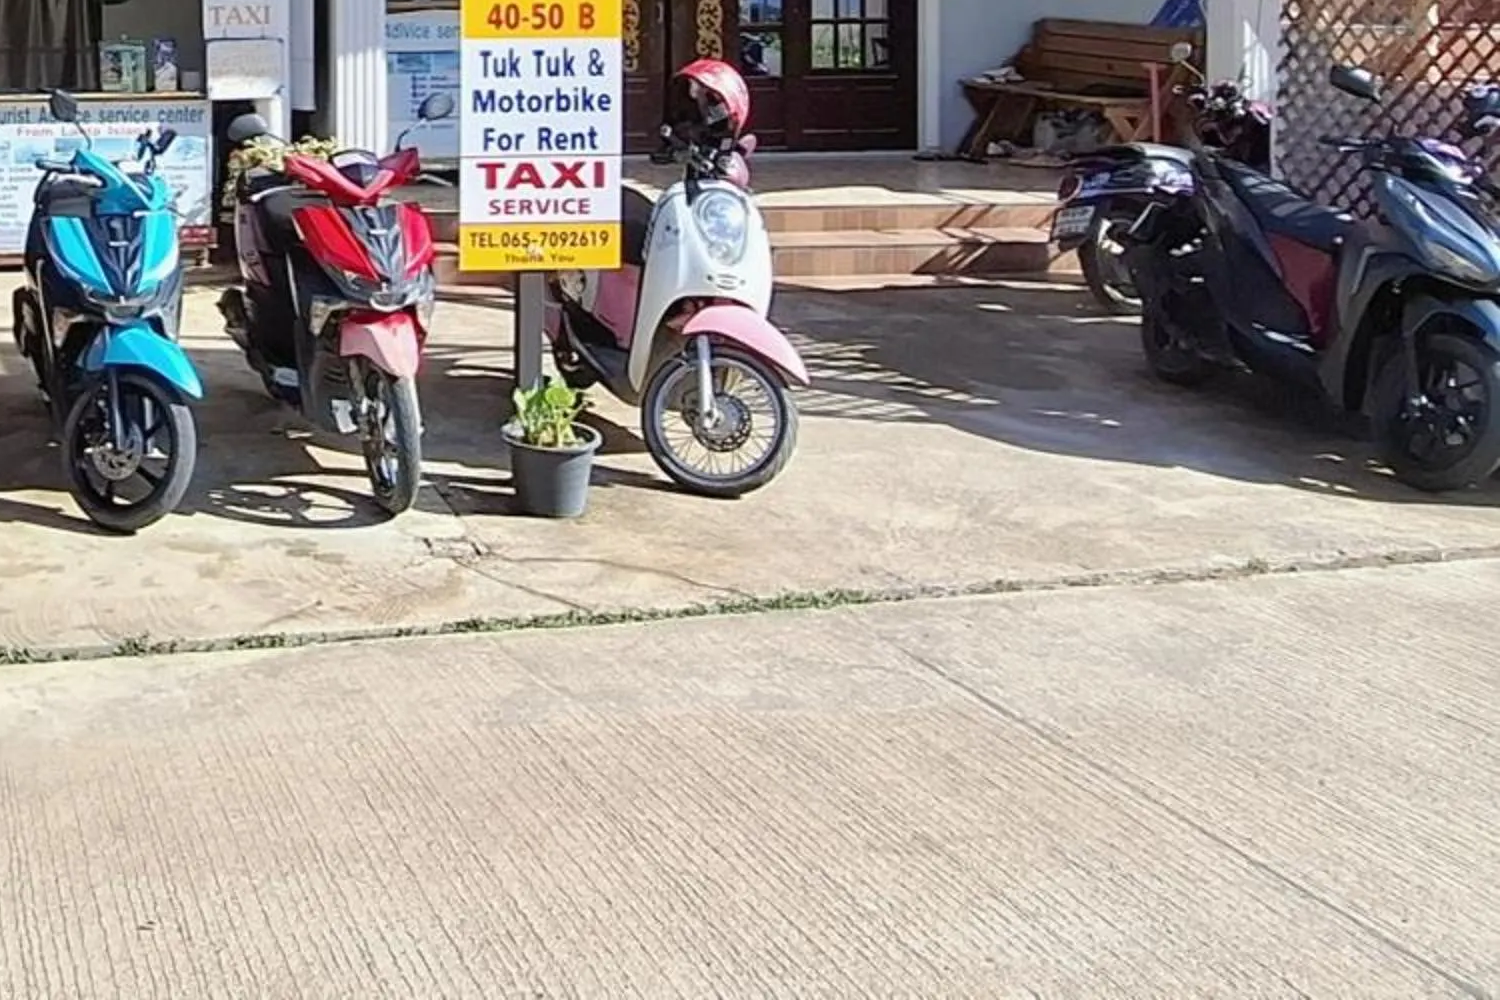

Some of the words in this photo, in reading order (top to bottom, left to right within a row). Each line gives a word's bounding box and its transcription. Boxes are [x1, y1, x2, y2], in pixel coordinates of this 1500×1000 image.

[208, 5, 271, 26] TAXI
[487, 2, 564, 31] 40-50
[579, 3, 595, 30] B
[479, 49, 521, 79] Tuk
[532, 49, 576, 78] Tuk
[588, 48, 605, 77] &
[472, 89, 612, 114] Motorbike
[98, 106, 149, 123] service
[157, 106, 204, 123] center
[483, 128, 524, 152] For
[538, 126, 598, 150] Rent
[476, 161, 606, 189] TAXI
[489, 199, 591, 216] SERVICE
